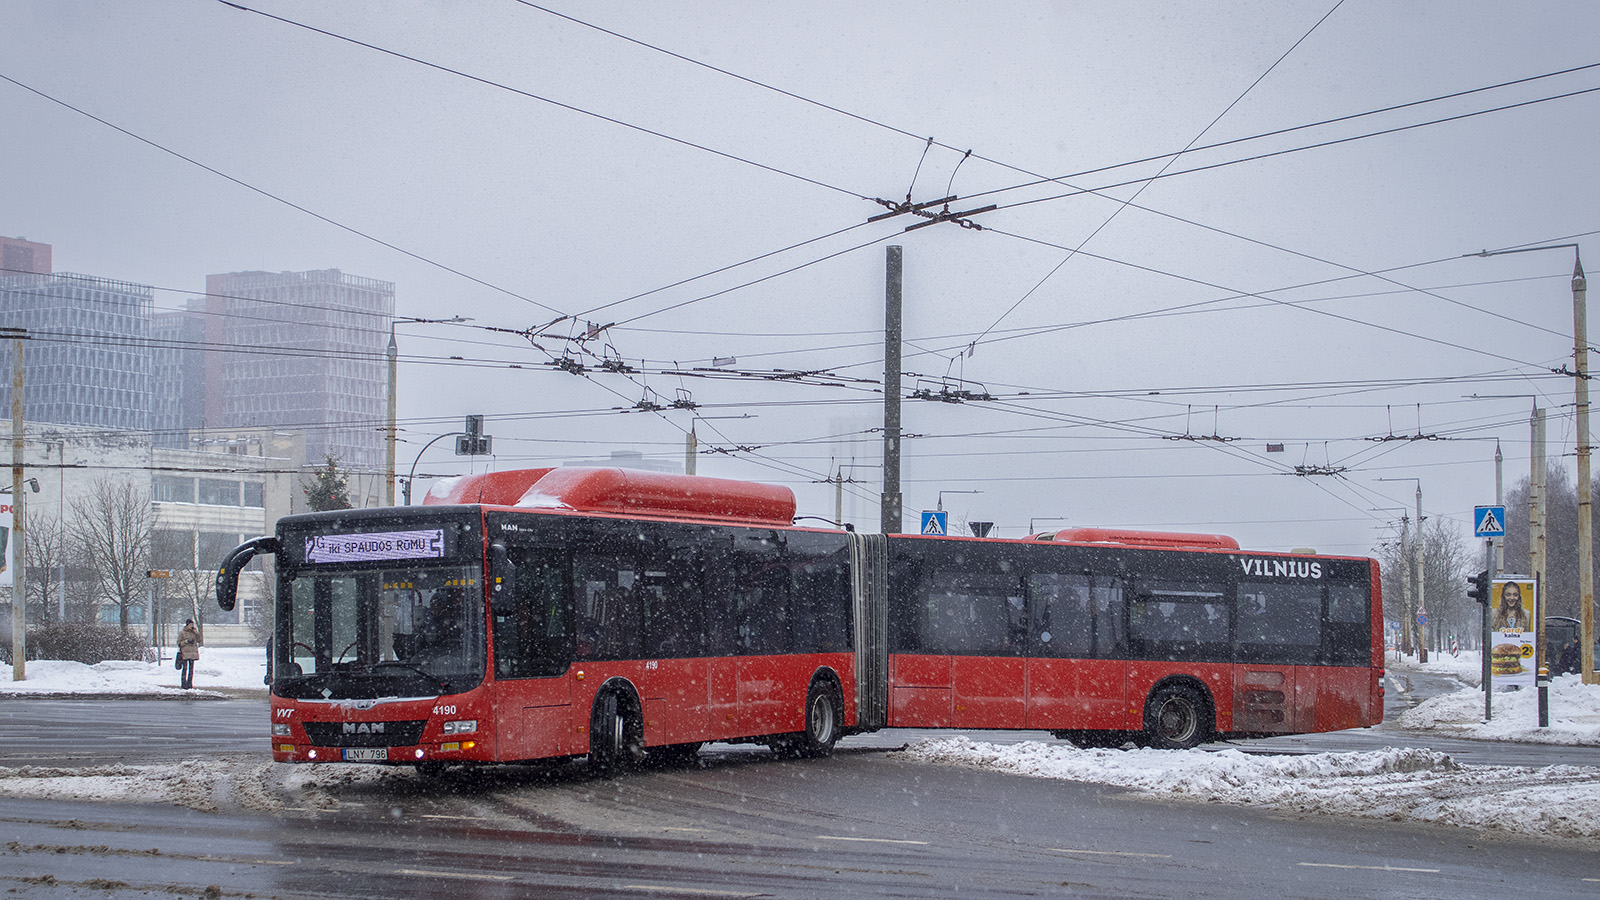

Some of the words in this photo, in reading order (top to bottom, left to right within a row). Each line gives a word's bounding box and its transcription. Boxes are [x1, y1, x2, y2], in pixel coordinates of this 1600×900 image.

[329, 543, 340, 554] iki
[344, 541, 392, 553] SPAUDOS
[1240, 558, 1322, 579] VILNIUS
[432, 705, 457, 715] 4190
[342, 722, 385, 734] MAN
[347, 750, 365, 759] LNY
[370, 749, 386, 759] 796
